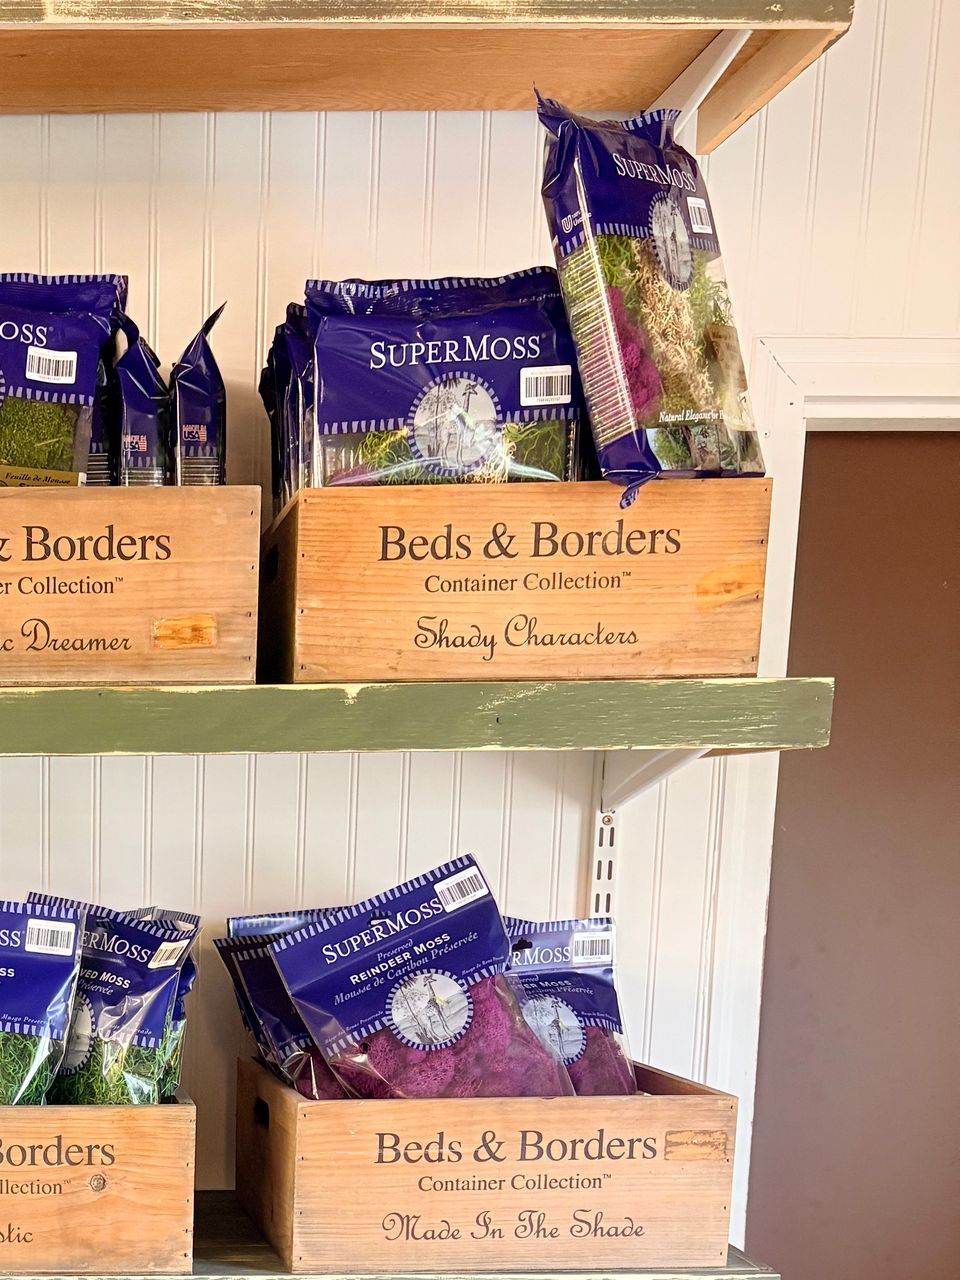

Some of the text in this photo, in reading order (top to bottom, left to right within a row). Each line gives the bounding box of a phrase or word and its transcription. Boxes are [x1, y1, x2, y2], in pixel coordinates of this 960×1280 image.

[370, 334, 540, 370] SUPERMOSS
[183, 430, 199, 441] USA
[45, 475, 70, 485] Mousse
[22, 524, 172, 562] Borders
[378, 519, 681, 562] Beds & Borders
[424, 574, 518, 593] Container
[20, 618, 132, 651] Dreamer
[414, 613, 639, 660] Shady Characters
[350, 933, 451, 985] REINDEER MOSS
[377, 939, 414, 961] Preserved
[100, 972, 131, 989] MOSS
[334, 932, 479, 1006] Mousse de Caribou Préservée
[374, 1130, 658, 1165] Beds & Borders
[418, 1175, 505, 1193] Container
[382, 1209, 645, 1242] Made In The Shade
